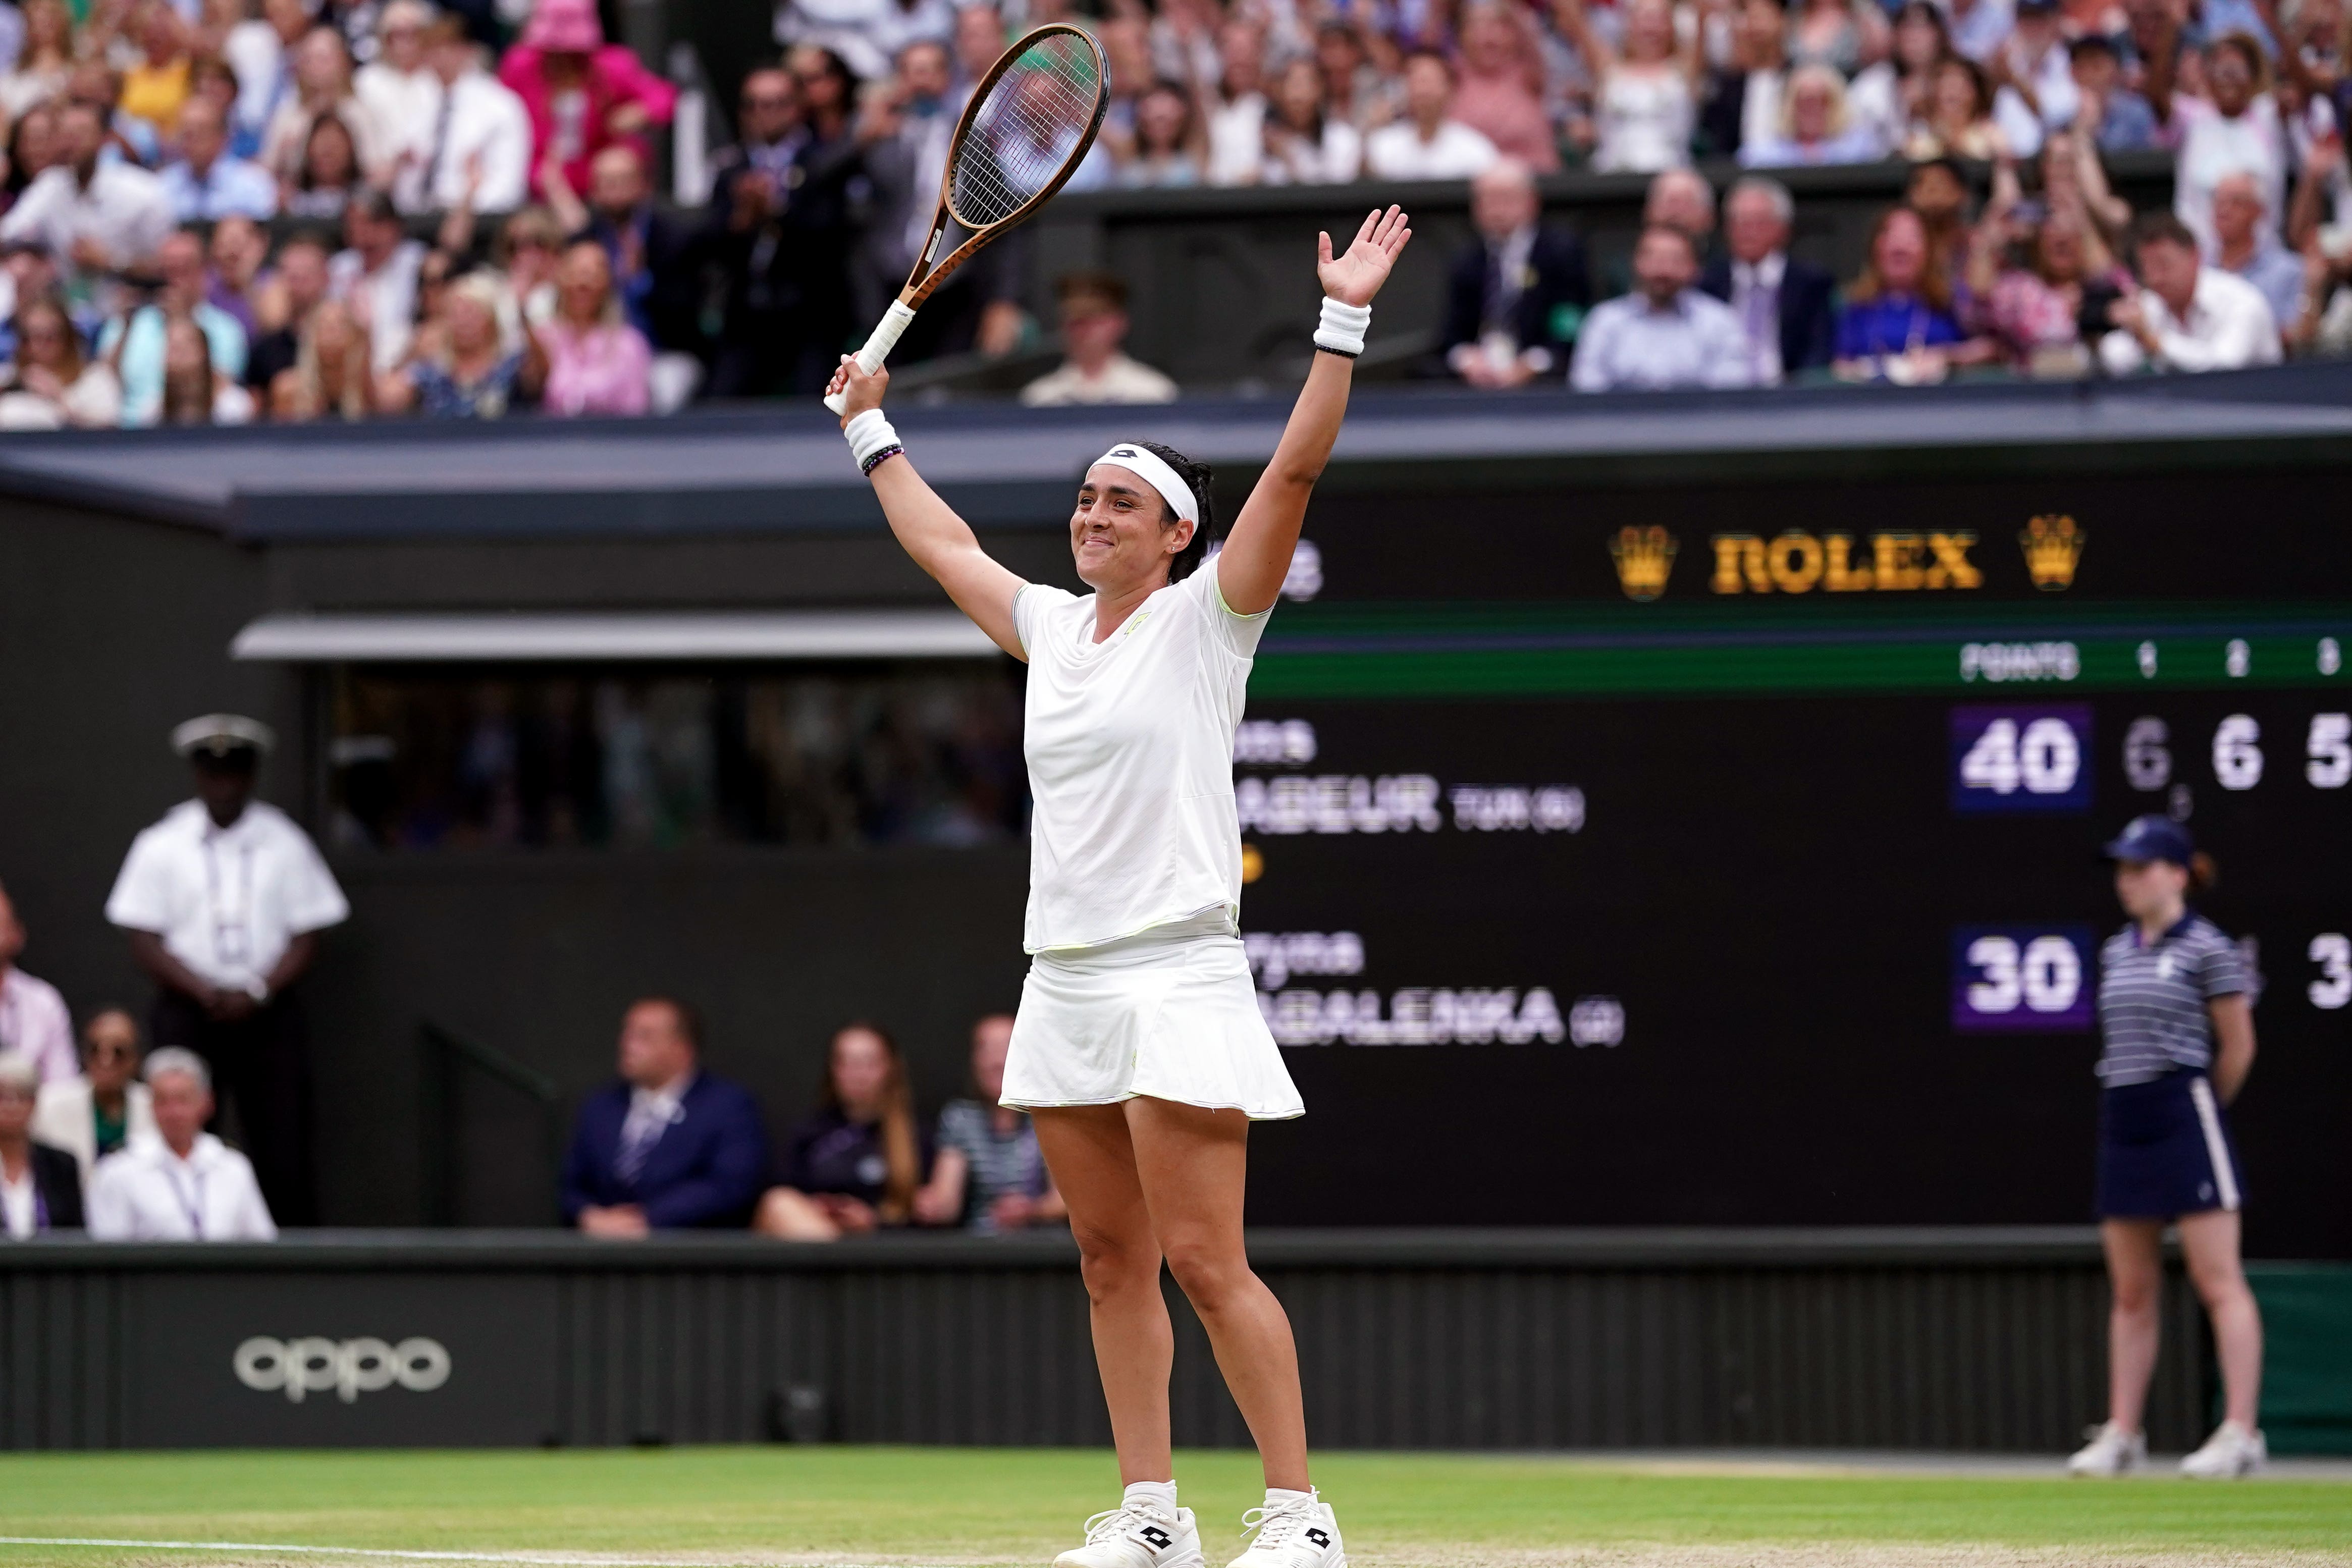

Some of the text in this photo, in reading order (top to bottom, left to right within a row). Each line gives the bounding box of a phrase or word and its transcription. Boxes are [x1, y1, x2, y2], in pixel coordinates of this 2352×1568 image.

[1712, 531, 1982, 594] ROLEX
[1959, 641, 2080, 682] POINTS
[1959, 712, 2352, 794] 40 6 6 5
[1237, 775, 1441, 834] ABEUR
[1243, 932, 1364, 989] ryna
[1965, 936, 2082, 1013] 30
[2309, 933, 2352, 1009] 3
[233, 1336, 452, 1403] oppo
